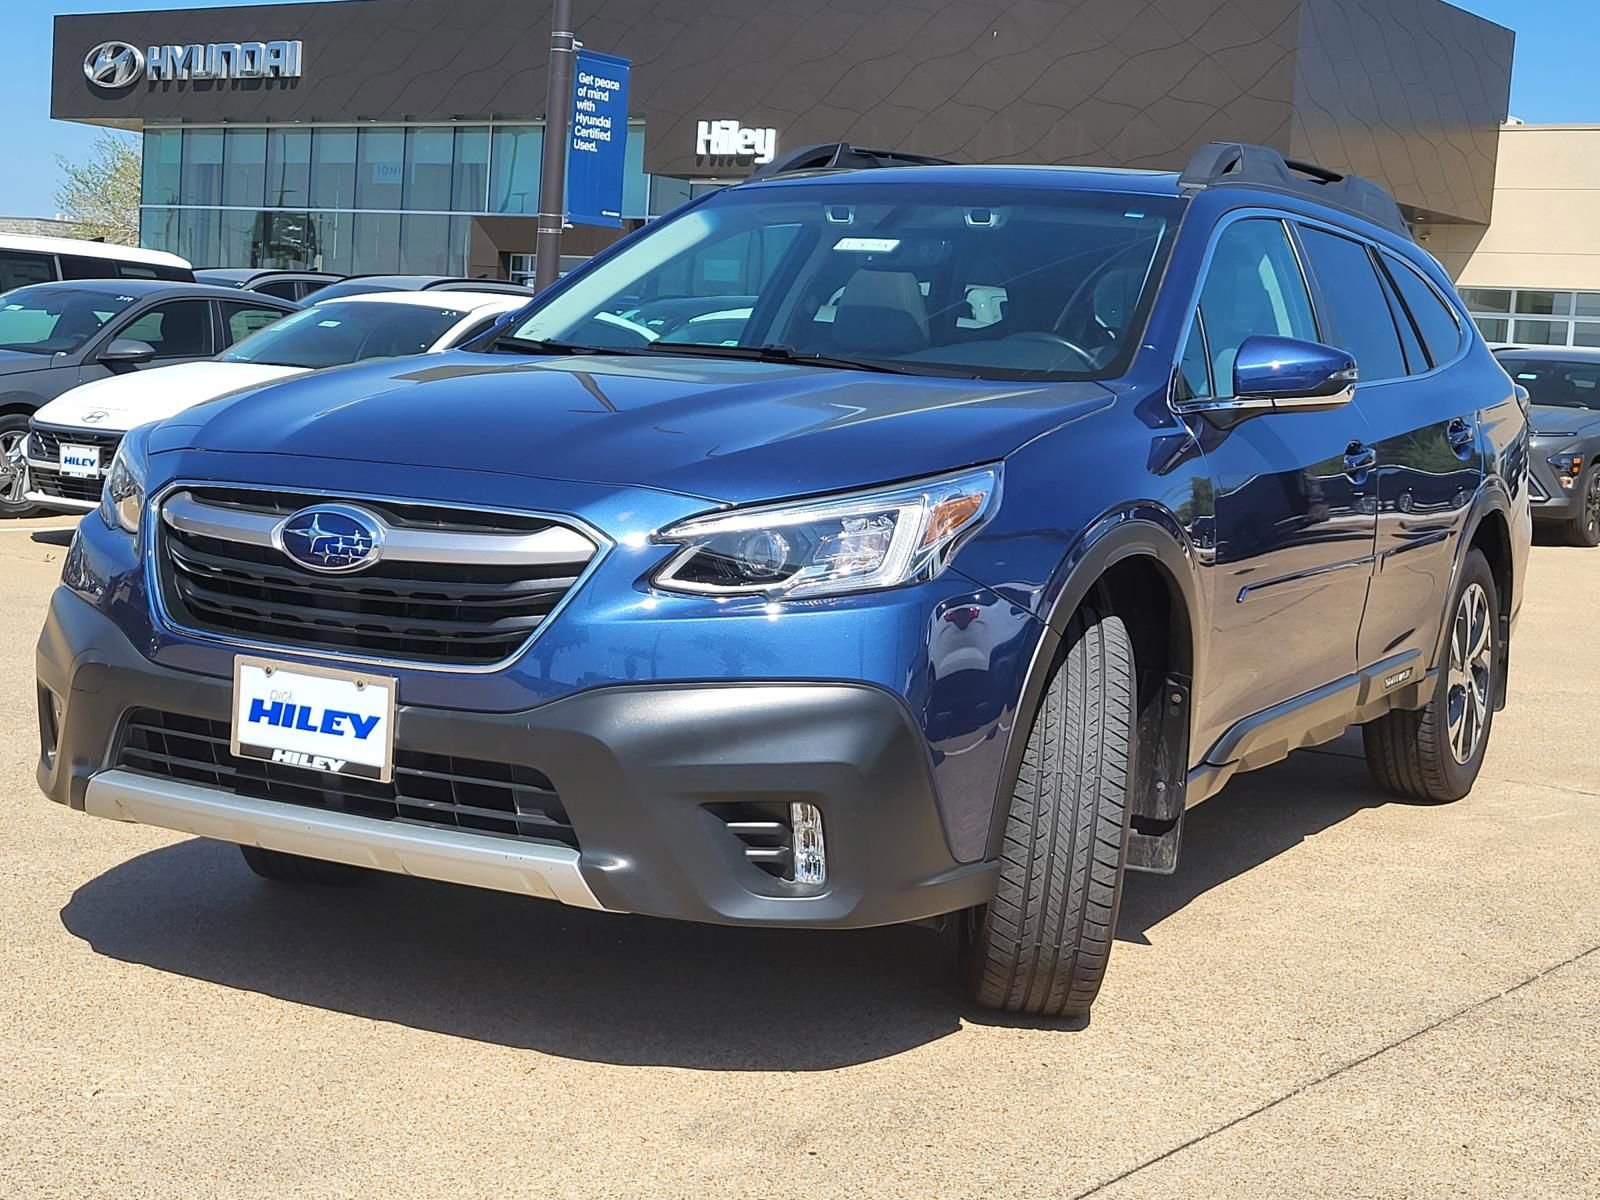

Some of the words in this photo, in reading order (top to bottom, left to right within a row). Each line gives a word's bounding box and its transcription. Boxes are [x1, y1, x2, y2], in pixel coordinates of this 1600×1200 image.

[146, 40, 303, 81] HYUNDAI
[578, 72, 594, 85] Get
[594, 77, 620, 91] peace
[577, 86, 587, 97] of
[587, 88, 609, 101] mind
[576, 99, 596, 112] with
[575, 112, 612, 128] Hyundai
[574, 125, 611, 142] Certified
[696, 120, 776, 164] Hiley
[573, 138, 598, 152] Used.
[63, 456, 97, 467] HILEY
[248, 698, 381, 740] HILEY
[271, 748, 347, 772] HILEY
